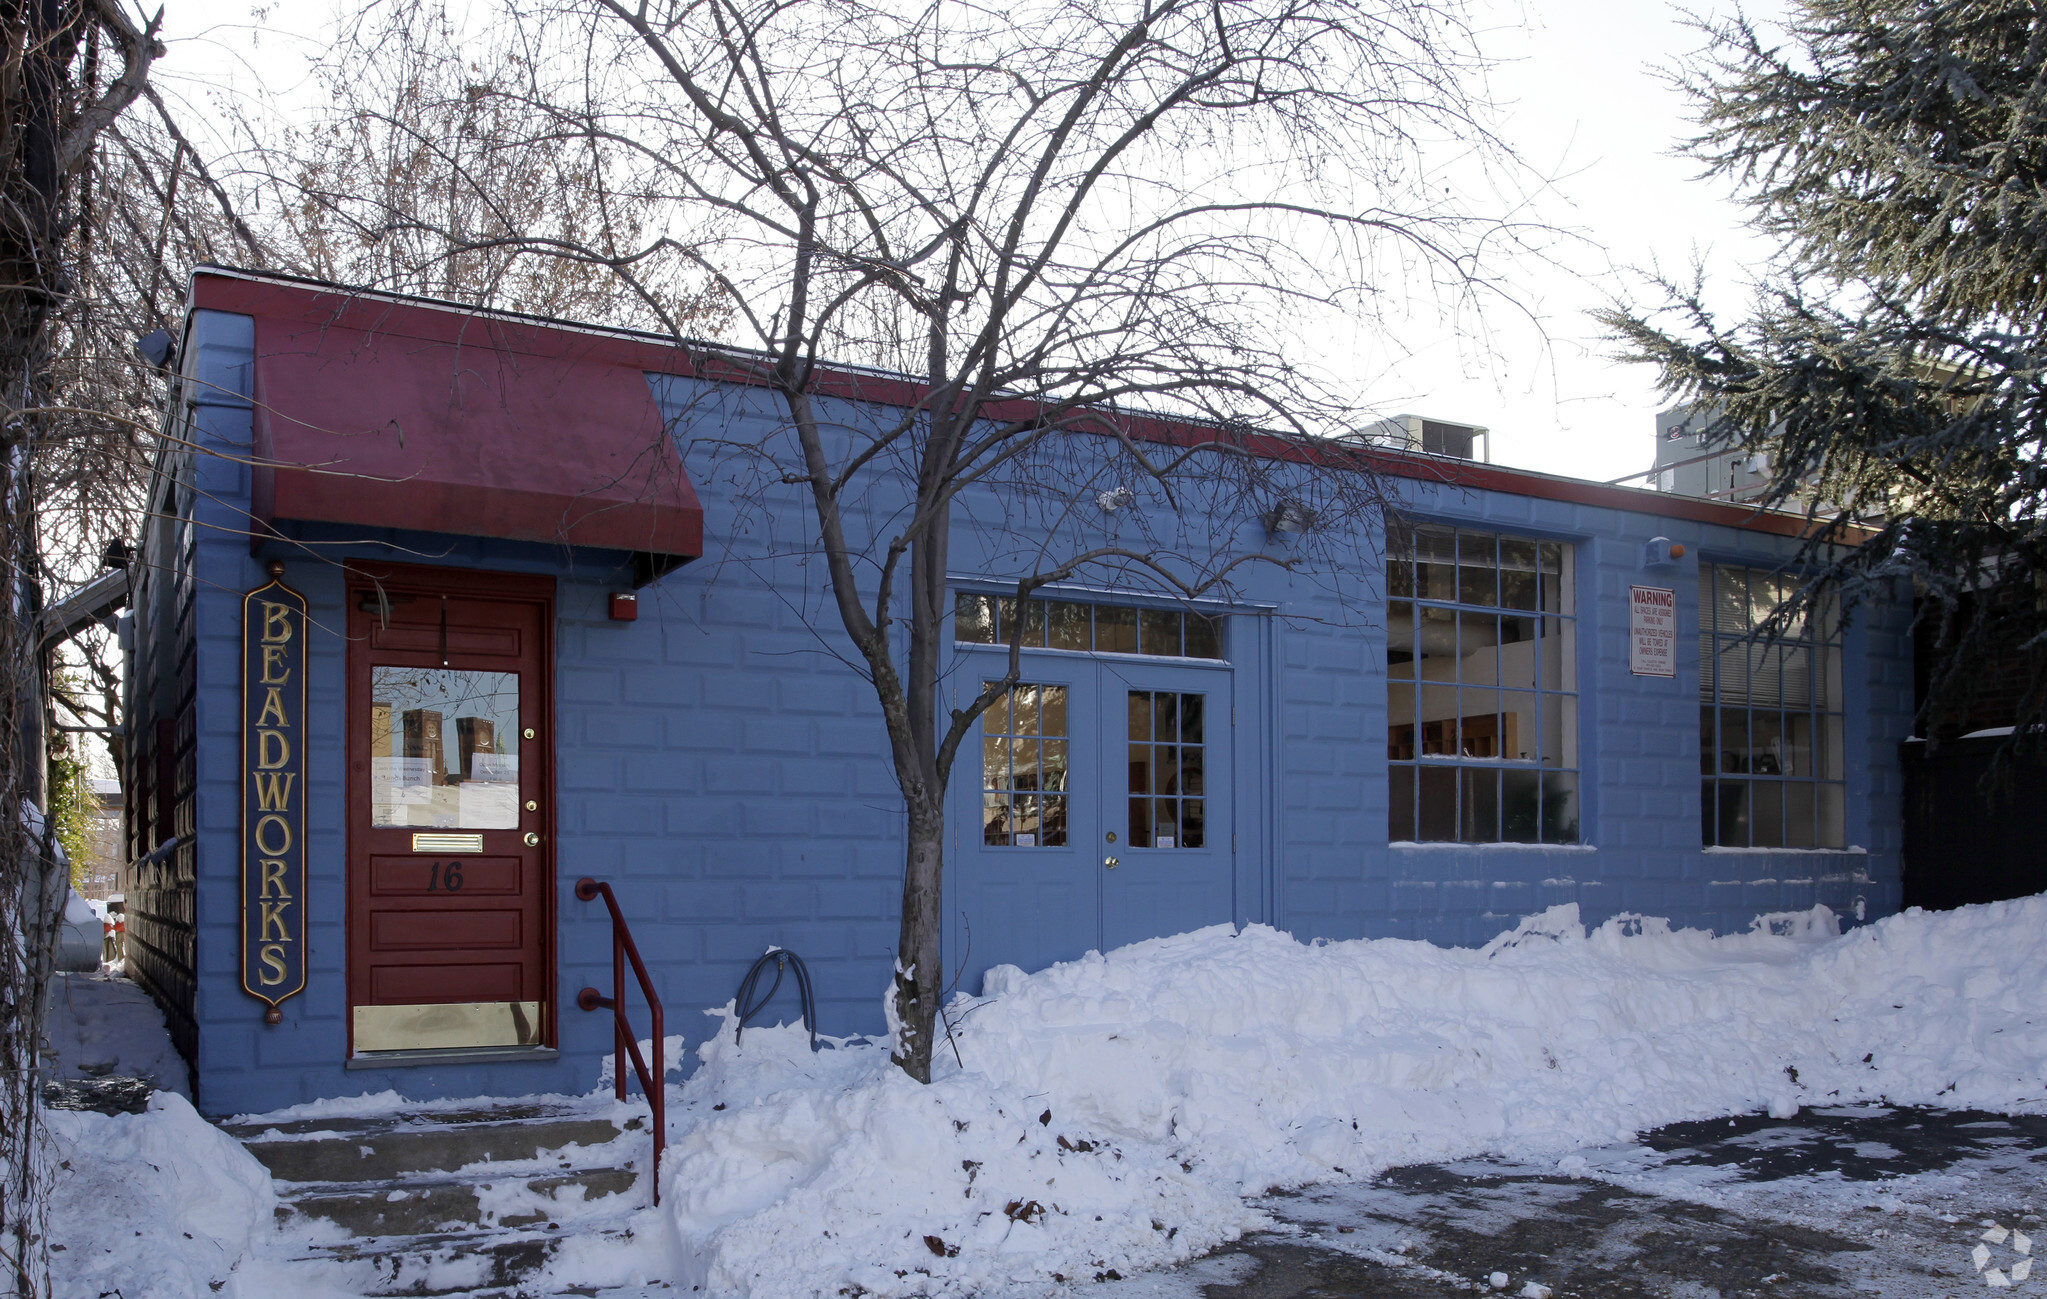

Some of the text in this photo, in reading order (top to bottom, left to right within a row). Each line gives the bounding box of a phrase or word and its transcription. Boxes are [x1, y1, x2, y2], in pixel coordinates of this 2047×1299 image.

[1633, 590, 1672, 607] WARNING
[253, 601, 295, 986] BEADWORKS
[427, 861, 464, 892] 16
